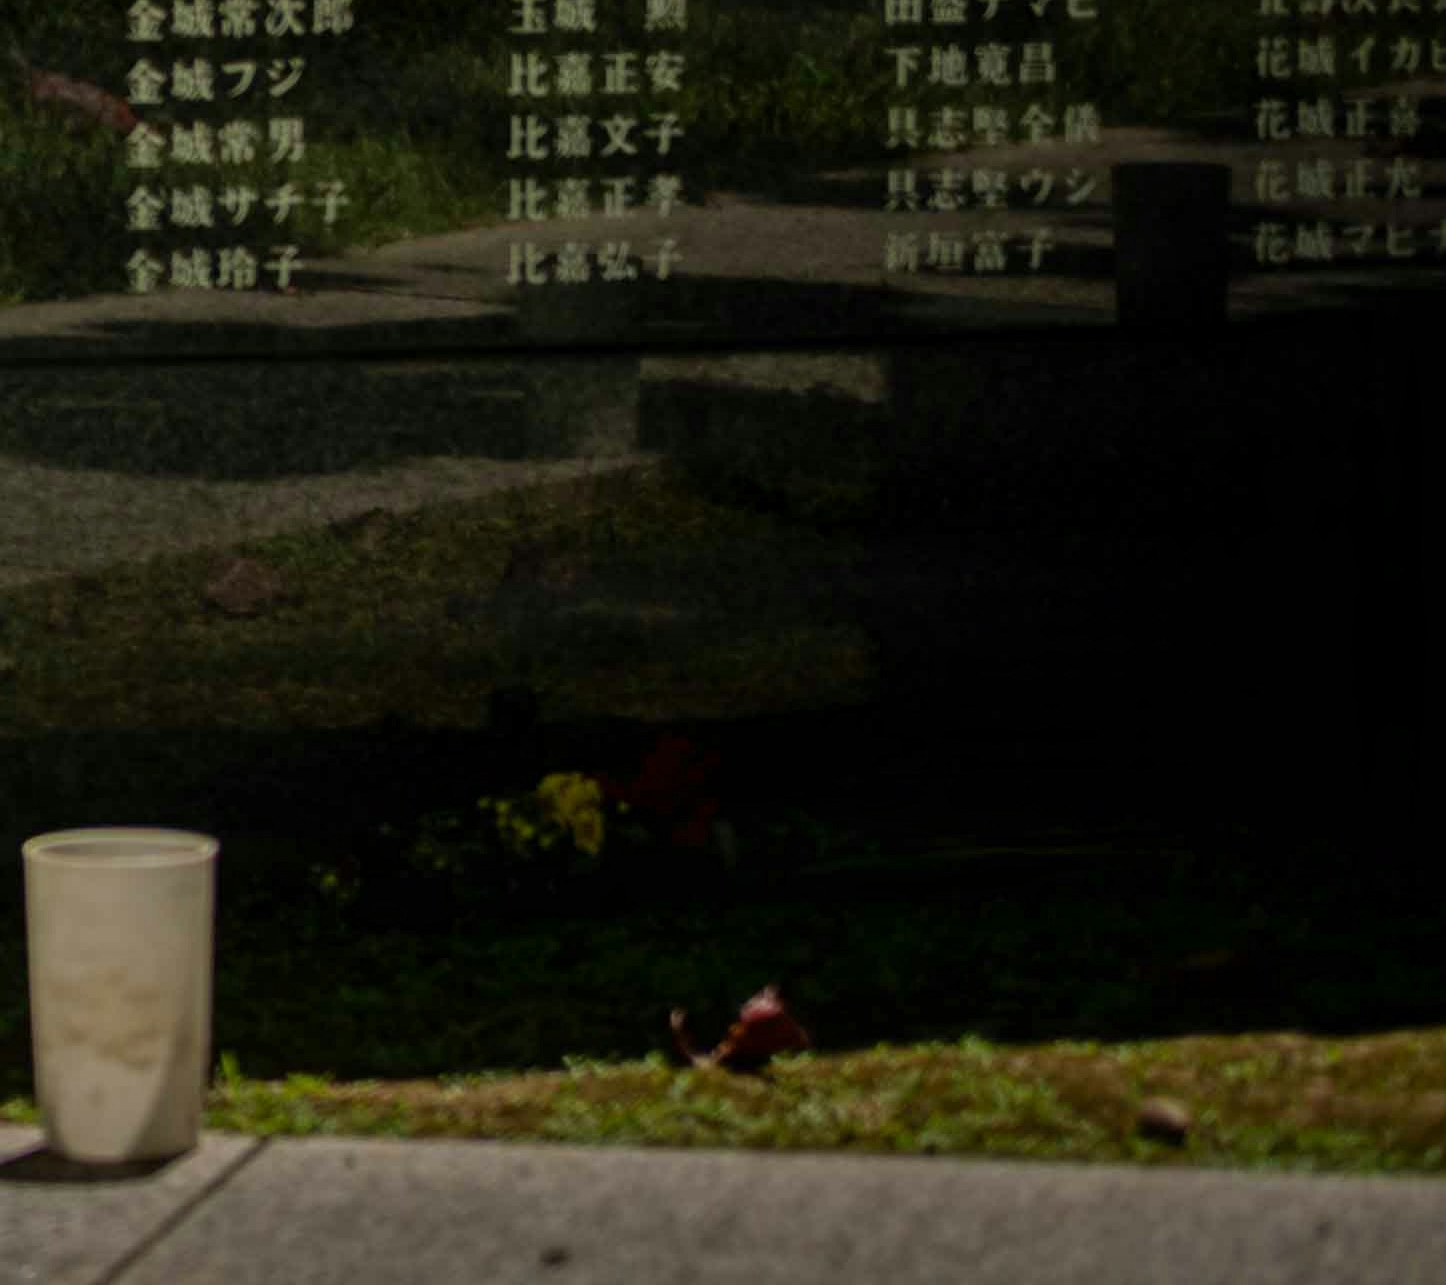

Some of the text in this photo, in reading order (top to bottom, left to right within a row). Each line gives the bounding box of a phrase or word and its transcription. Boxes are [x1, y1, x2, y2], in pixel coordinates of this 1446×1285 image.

[128, 57, 305, 104] 金城フジ
[506, 50, 686, 98] 比嘉正安
[127, 117, 306, 169] 金城常男
[506, 111, 684, 160] 比嘉文子
